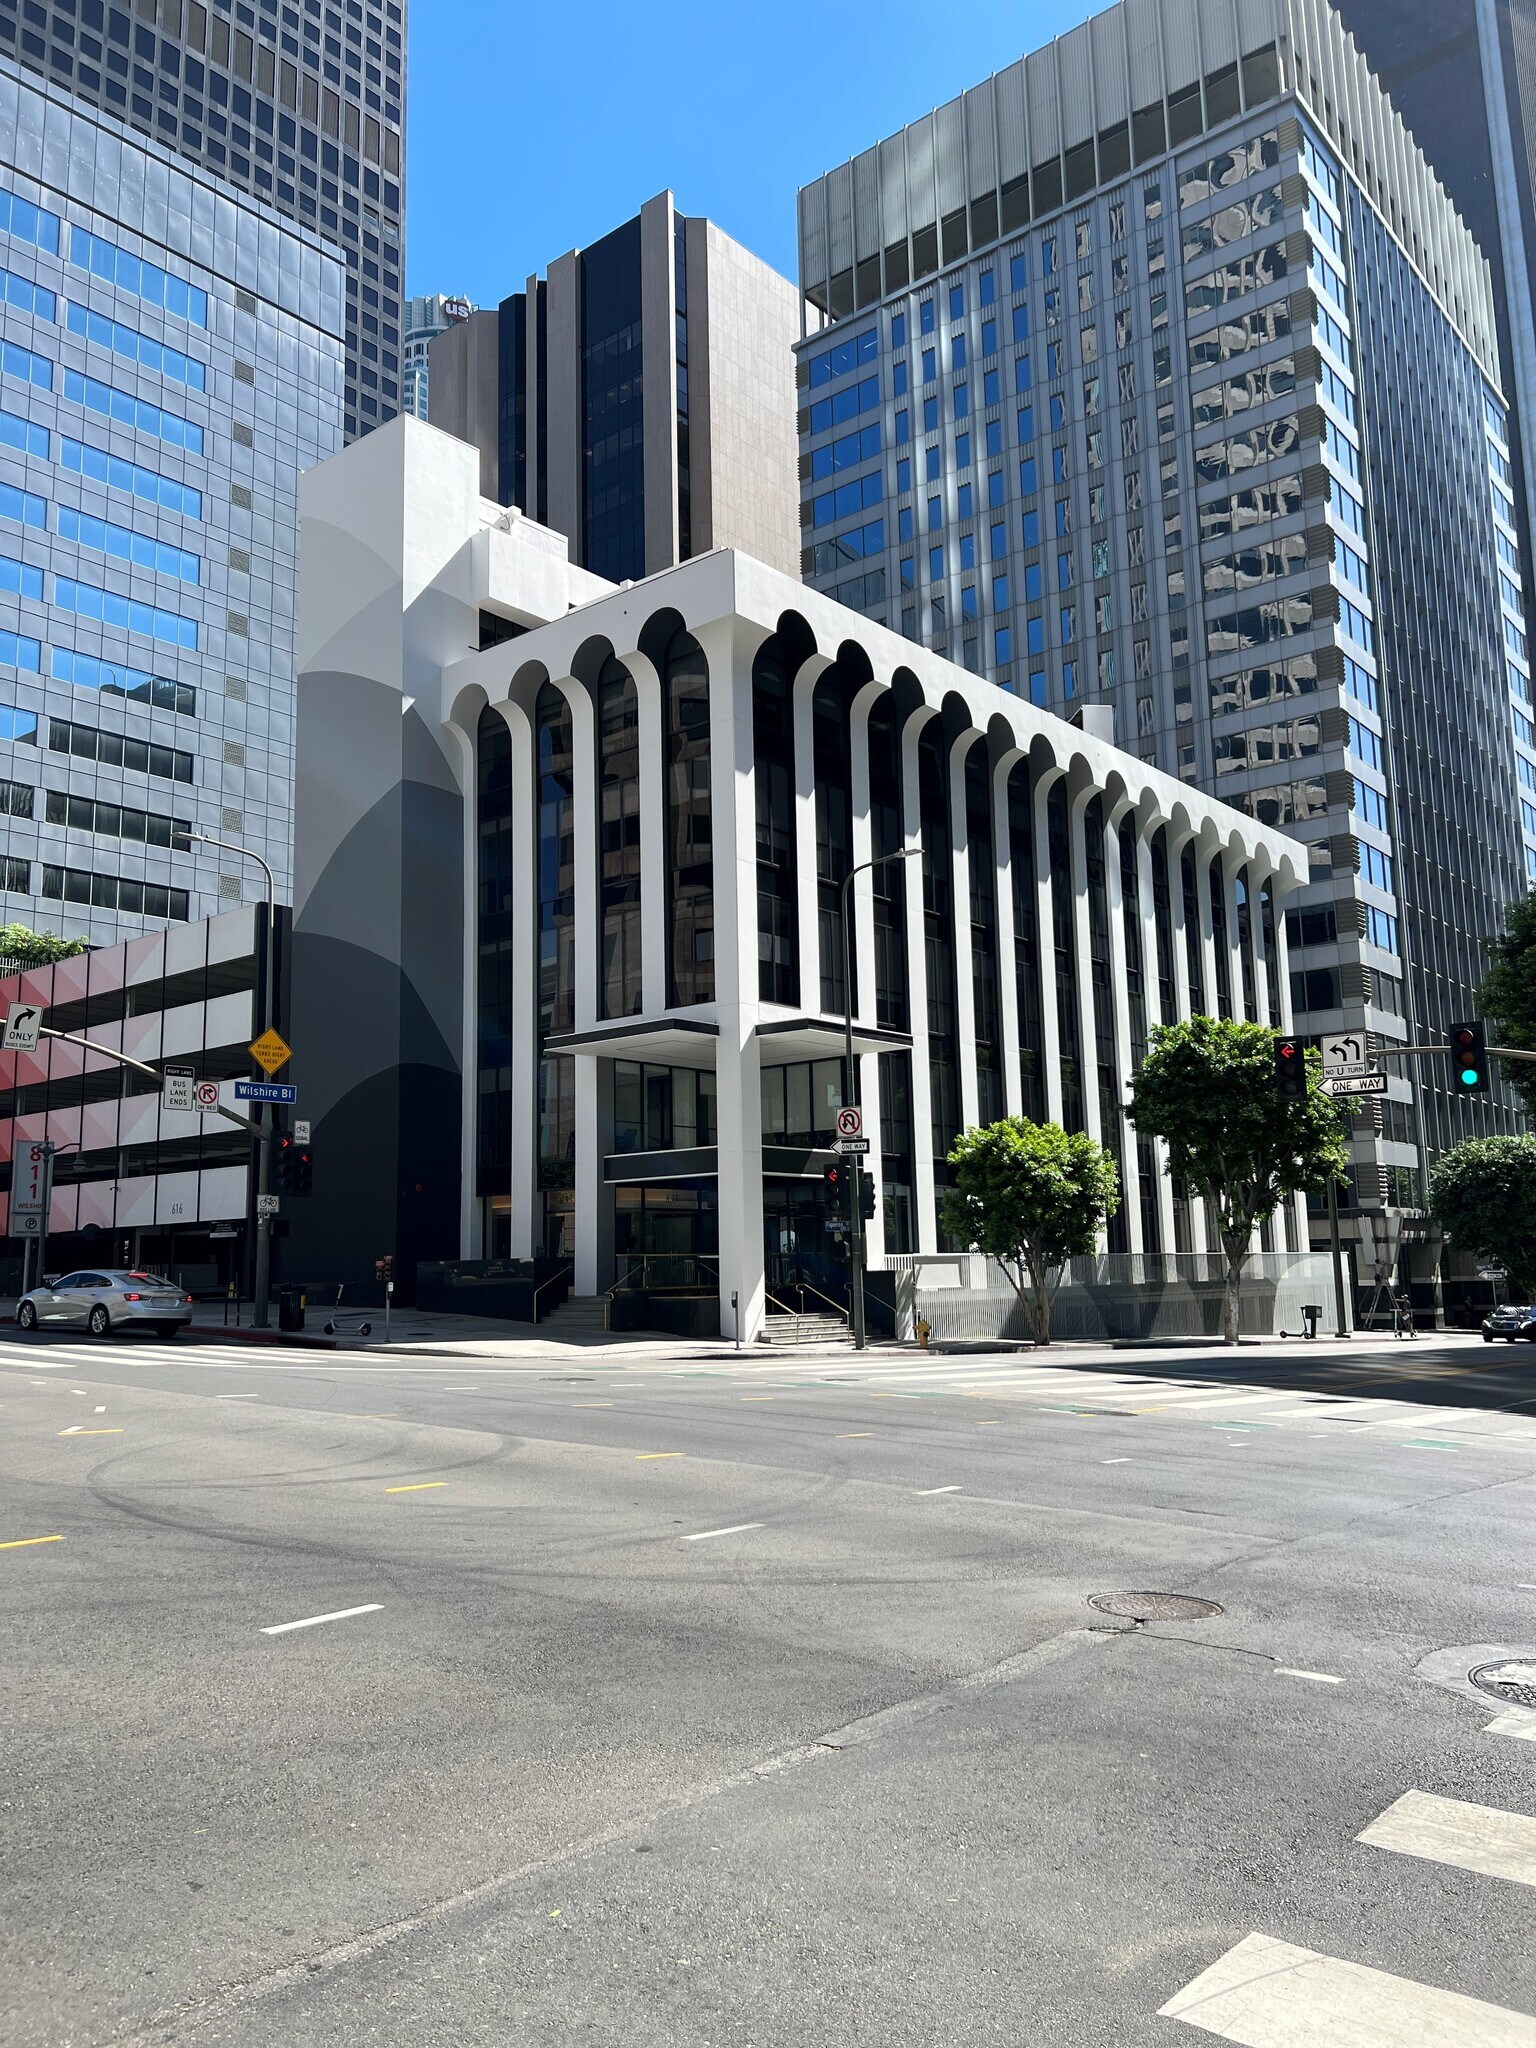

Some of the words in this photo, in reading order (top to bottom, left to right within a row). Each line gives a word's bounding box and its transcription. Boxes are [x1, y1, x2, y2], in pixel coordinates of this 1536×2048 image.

[445, 303, 469, 318] us
[9, 1031, 34, 1041] ONLY
[1337, 1067, 1344, 1076] U
[172, 1080, 187, 1088] BUS
[1332, 1081, 1353, 1092] ONE
[1360, 1078, 1381, 1090] WAY
[170, 1089, 188, 1097] LANE
[239, 1085, 278, 1098] Wilshire
[170, 1098, 188, 1106] ENDS
[171, 1203, 183, 1215] 616
